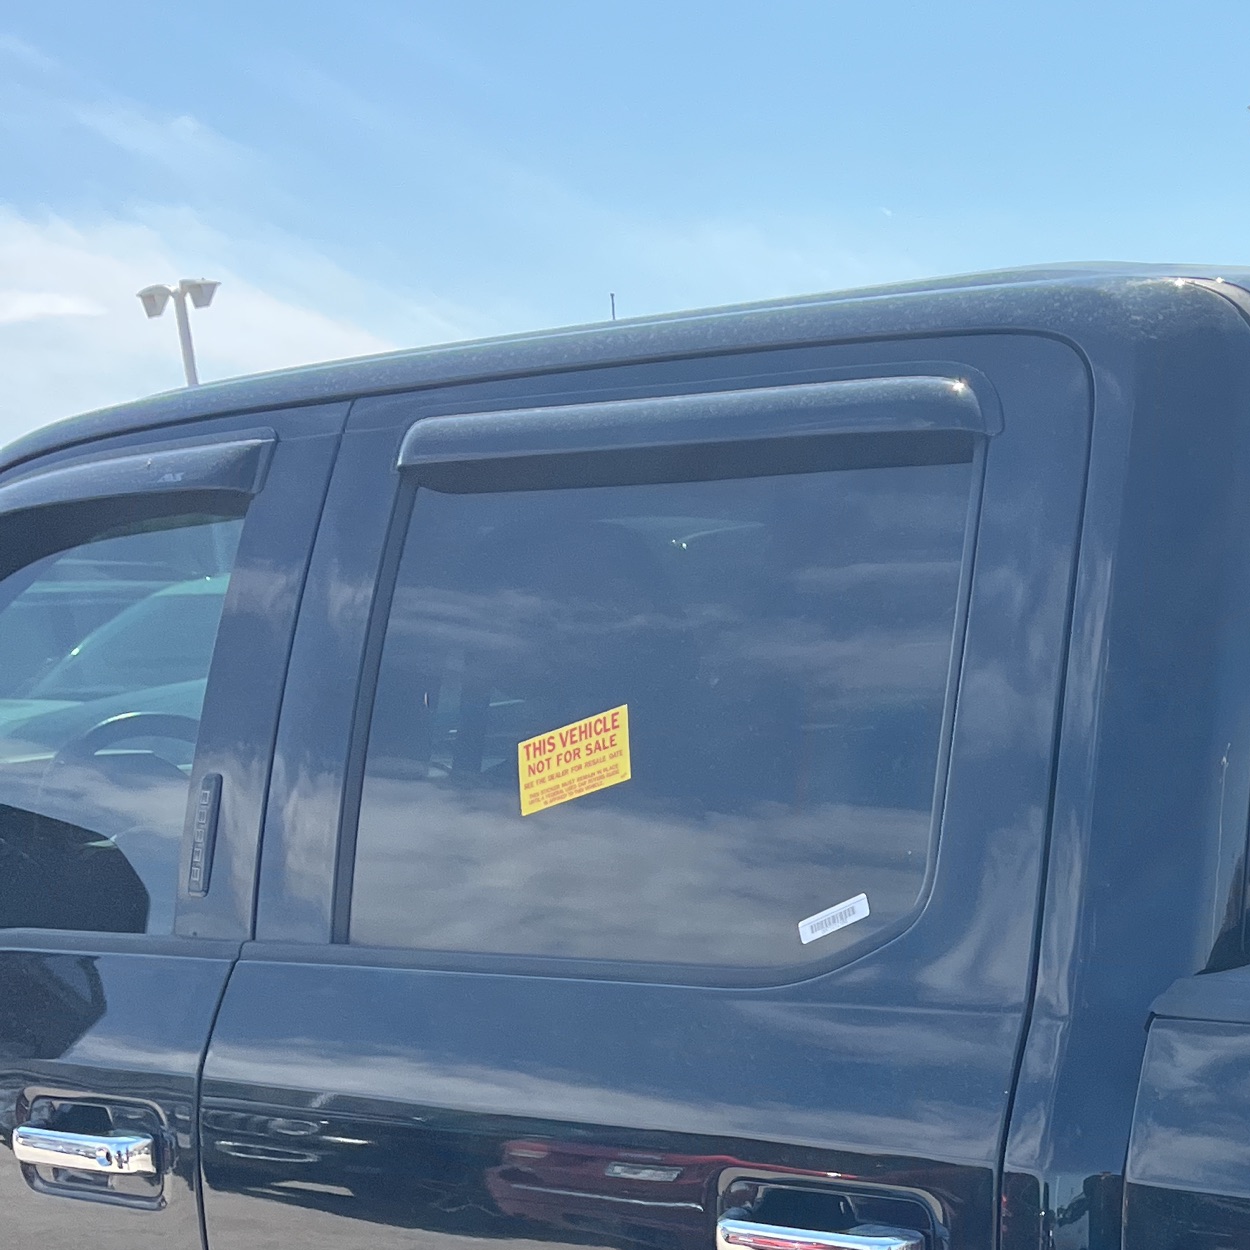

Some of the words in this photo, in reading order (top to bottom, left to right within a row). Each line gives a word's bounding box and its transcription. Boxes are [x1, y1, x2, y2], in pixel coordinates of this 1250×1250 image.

[523, 735, 556, 761] THIS
[559, 711, 620, 748] VEHICLE
[528, 757, 552, 777] NOT
[556, 747, 581, 767] FOR
[585, 733, 618, 756] SALE
[548, 769, 569, 781] DEALER
[571, 764, 583, 773] FOR
[584, 755, 606, 768] RESALE
